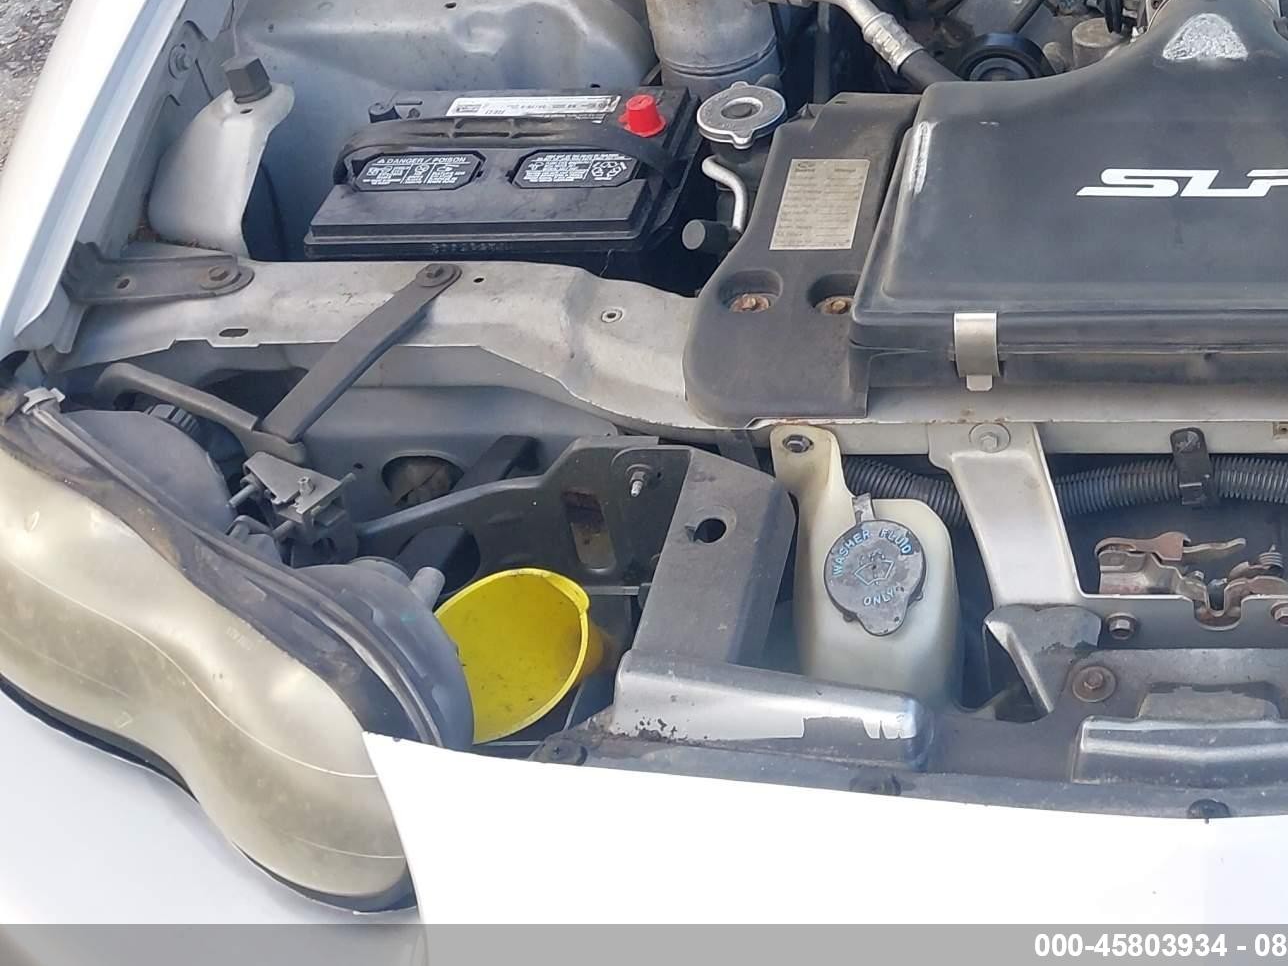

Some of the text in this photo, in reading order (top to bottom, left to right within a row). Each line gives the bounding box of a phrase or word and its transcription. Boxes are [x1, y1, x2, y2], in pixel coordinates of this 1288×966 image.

[832, 528, 913, 578] WASHER FLUID
[863, 588, 896, 606] ONLY
